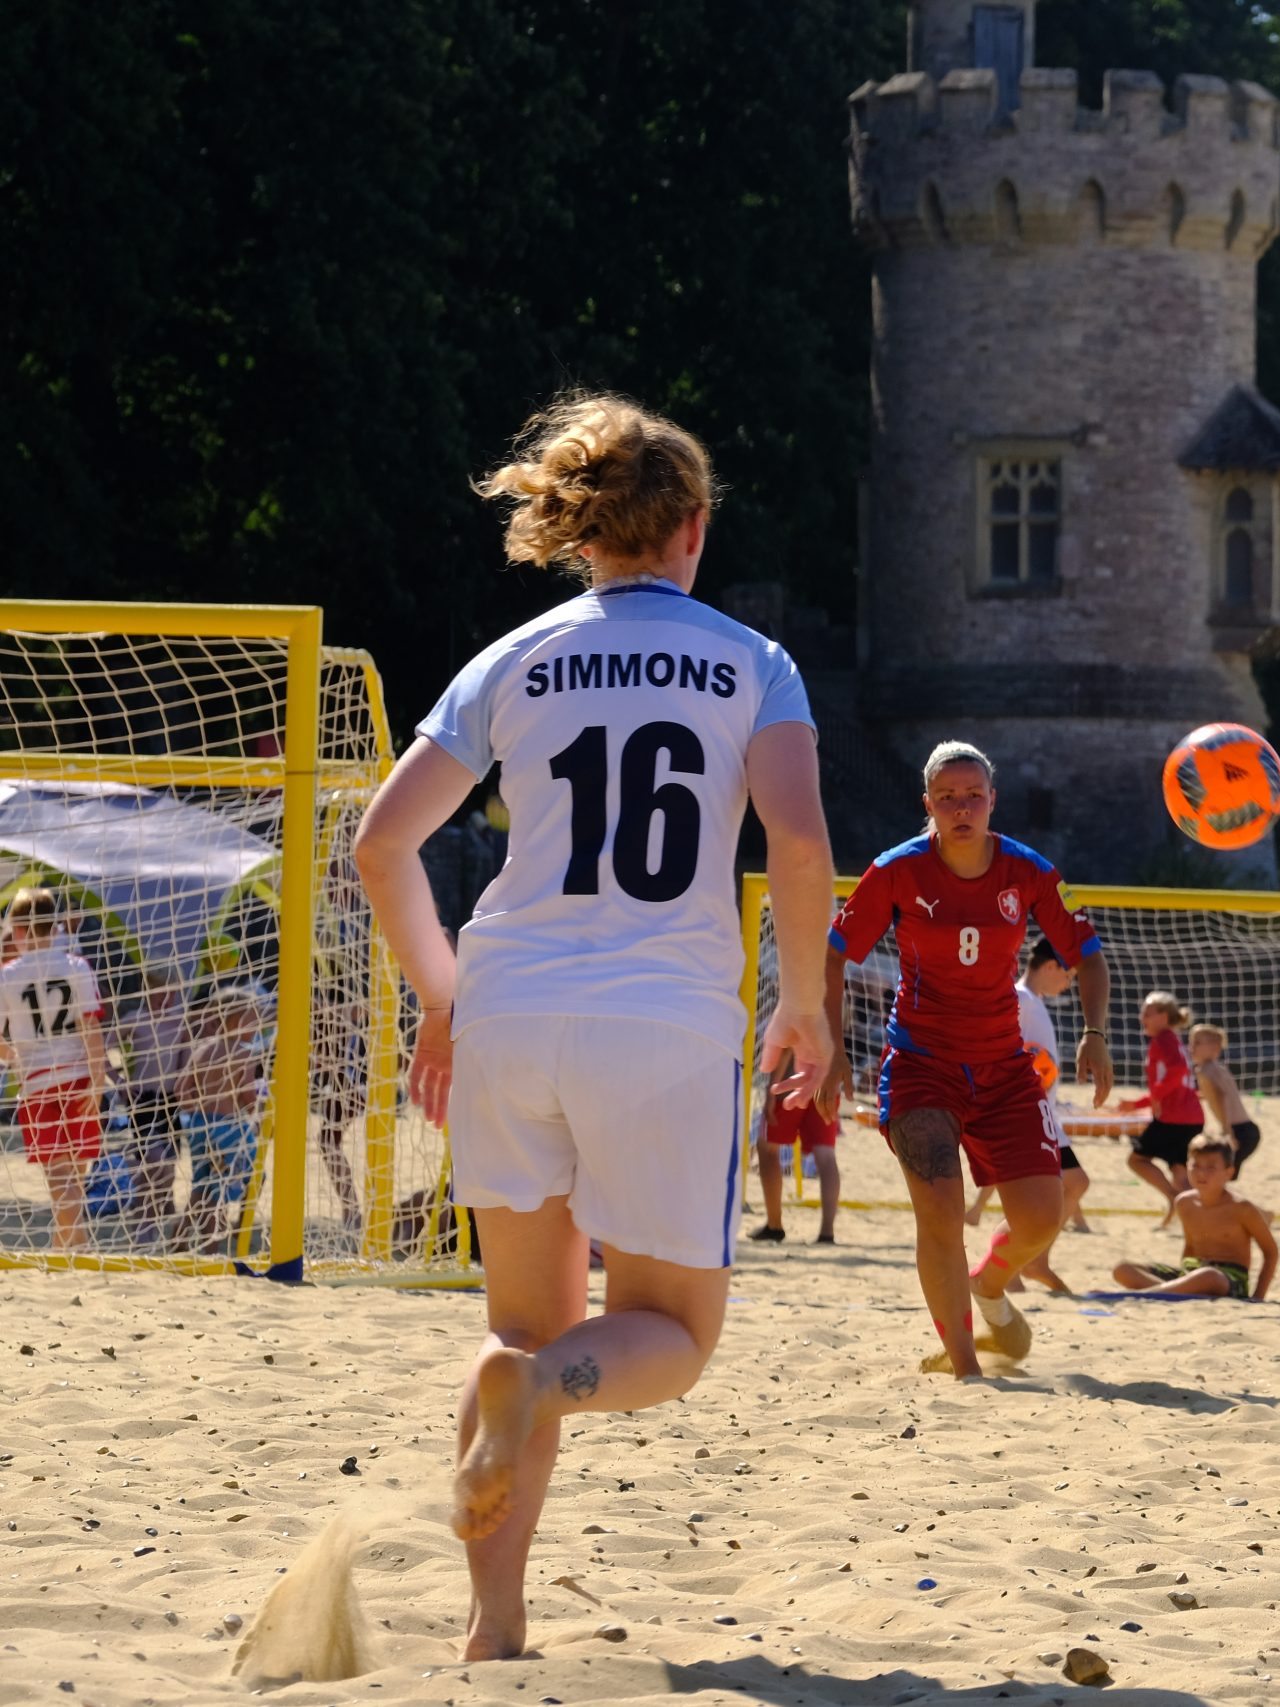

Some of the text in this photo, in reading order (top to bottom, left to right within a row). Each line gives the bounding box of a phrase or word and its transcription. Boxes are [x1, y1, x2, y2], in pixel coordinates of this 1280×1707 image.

[525, 652, 736, 698] SIMMONS
[549, 720, 705, 902] 16
[958, 926, 980, 966] 8
[21, 979, 76, 1038] 12
[1037, 1099, 1057, 1141] 8
